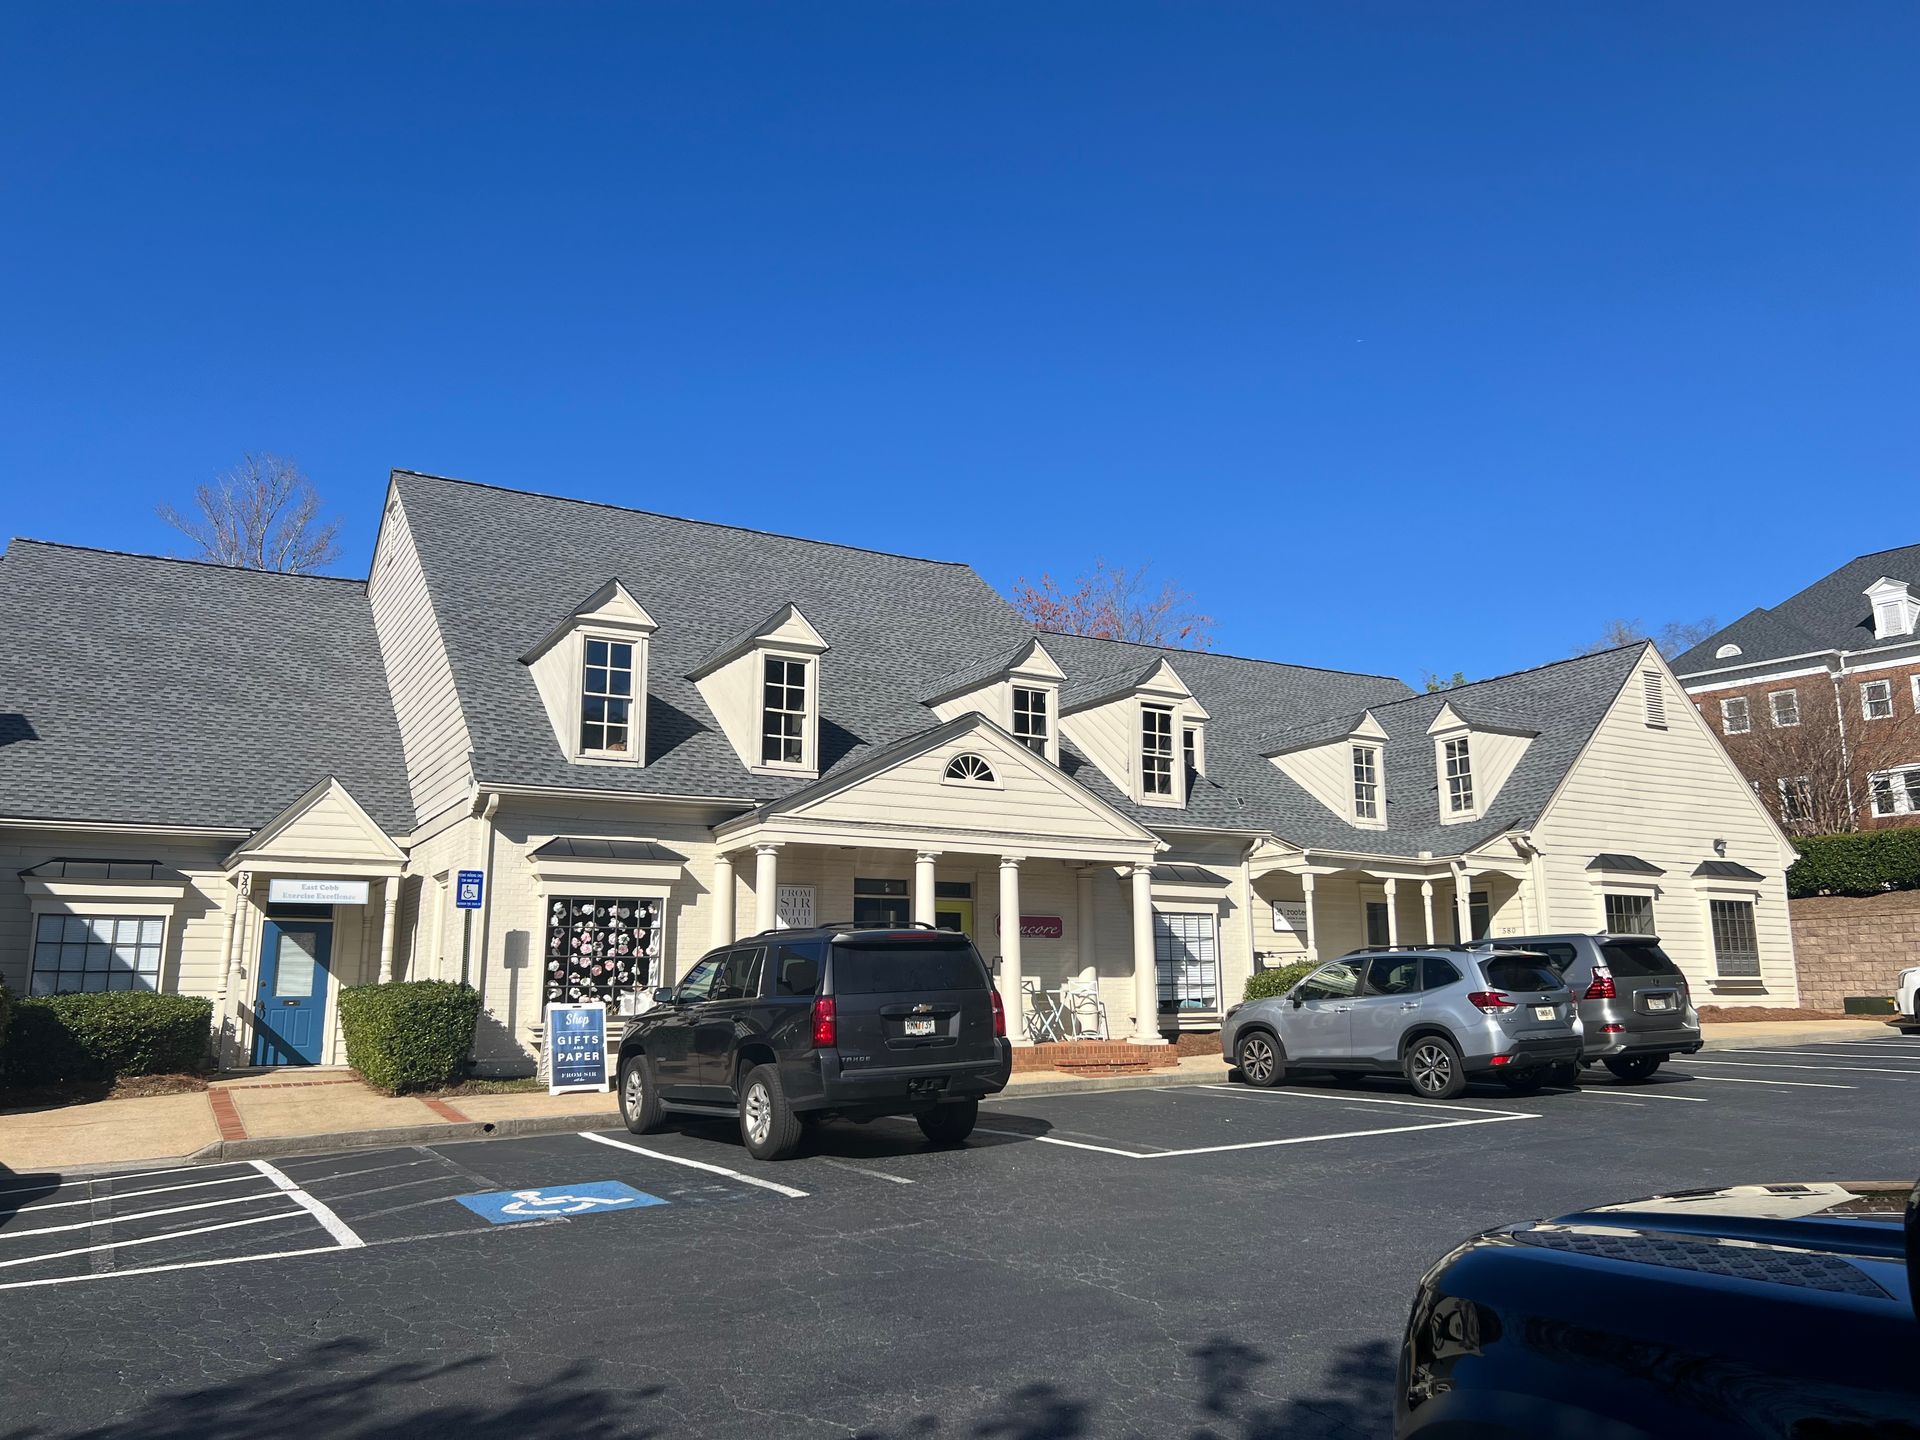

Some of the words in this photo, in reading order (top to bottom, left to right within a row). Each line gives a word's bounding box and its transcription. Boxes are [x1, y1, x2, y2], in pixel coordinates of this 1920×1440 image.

[316, 892, 356, 900] Excellence
[781, 889, 811, 897] FROM
[781, 897, 810, 908] SIR
[781, 908, 811, 917] WITH
[781, 917, 811, 926] LOVE
[1019, 925, 1060, 934] ncore
[566, 1013, 590, 1028] Shop
[557, 1035, 599, 1046] GIFTS
[557, 1051, 600, 1062] PAPER
